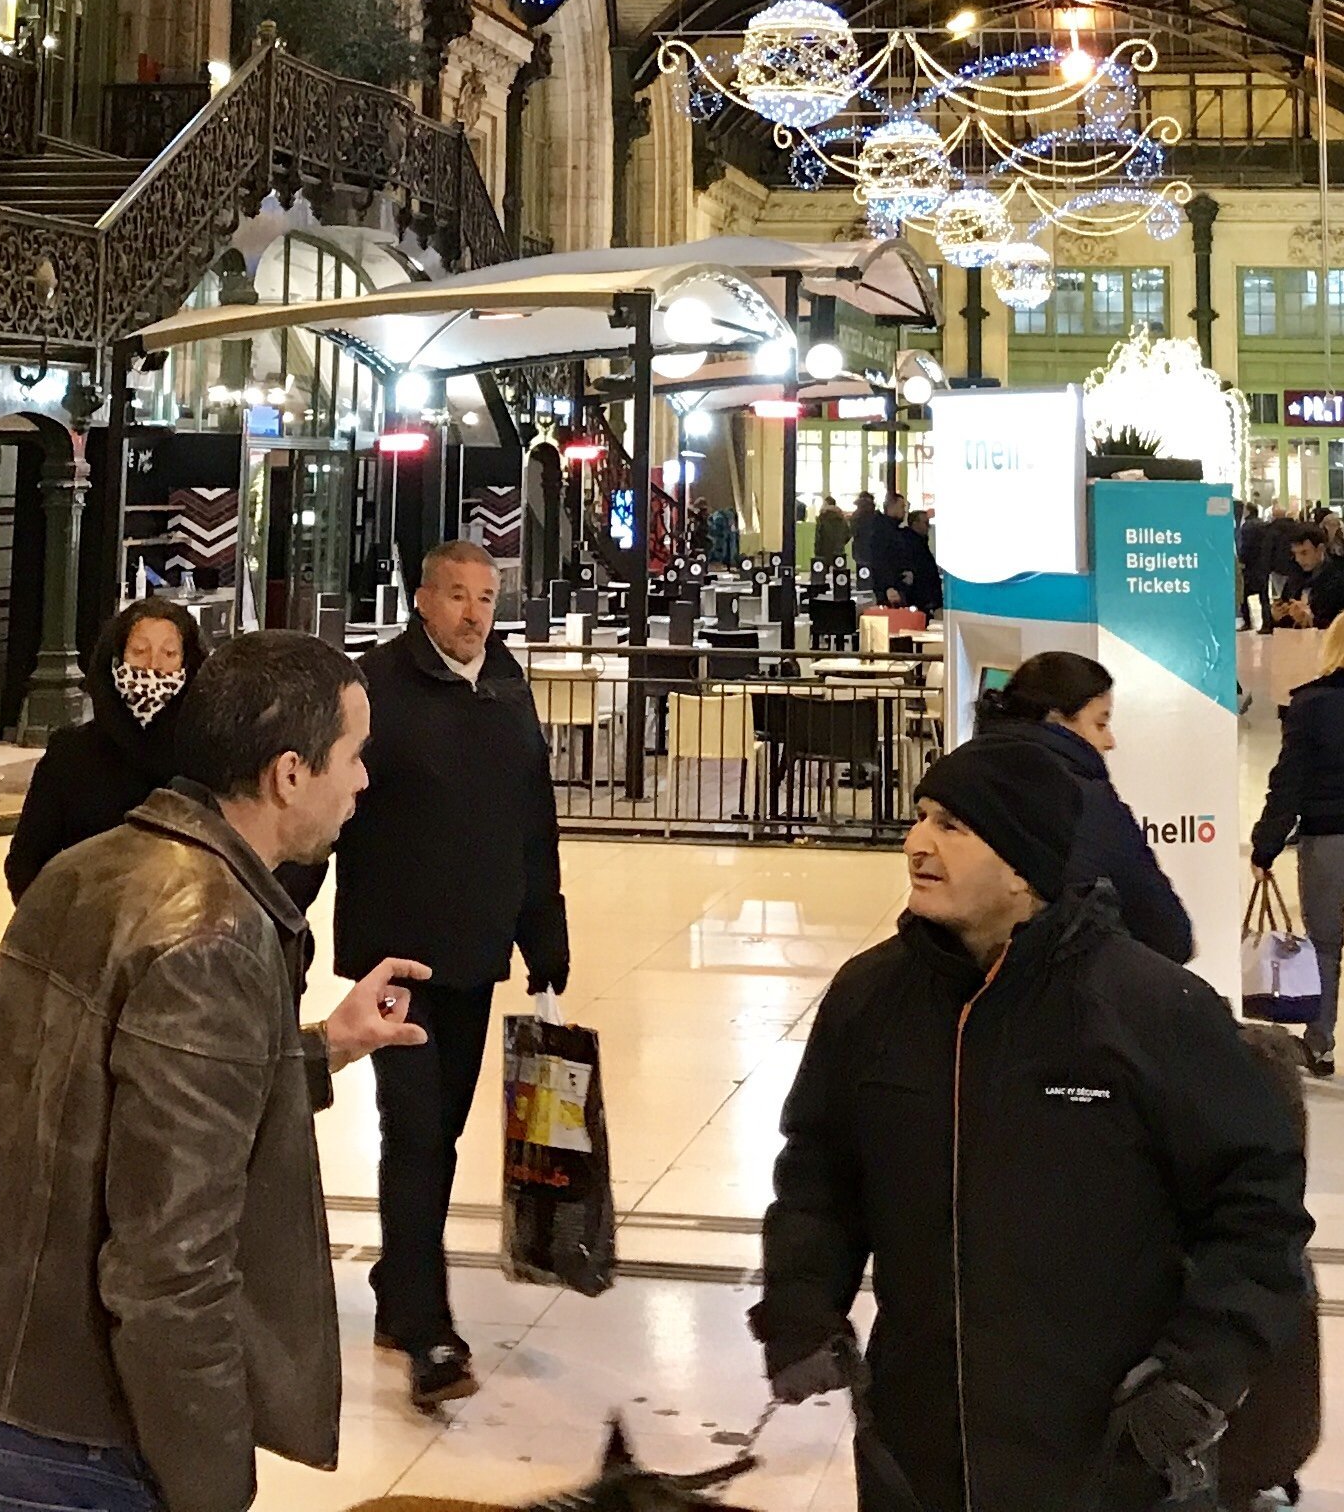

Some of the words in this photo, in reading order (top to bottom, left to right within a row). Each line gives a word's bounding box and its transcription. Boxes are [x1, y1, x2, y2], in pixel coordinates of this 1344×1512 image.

[1125, 528, 1182, 544] Billets
[1125, 552, 1199, 572] Biglietti
[1126, 576, 1191, 594] Tickets
